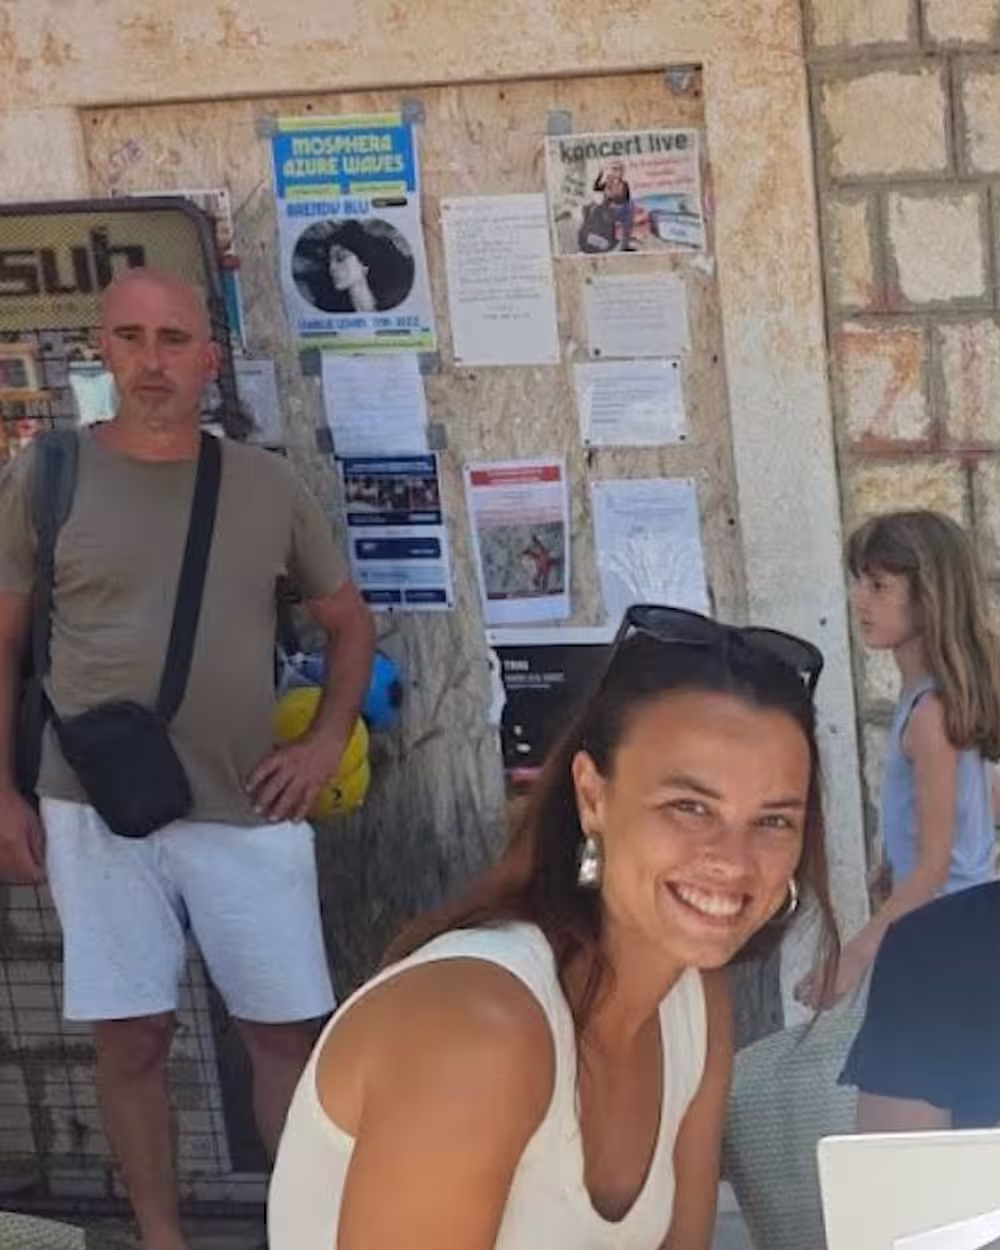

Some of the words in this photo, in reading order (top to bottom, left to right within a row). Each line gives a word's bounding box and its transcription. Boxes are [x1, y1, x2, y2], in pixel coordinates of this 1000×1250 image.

[559, 134, 642, 164] koncert
[648, 132, 688, 154] live
[343, 154, 404, 176] WAVES
